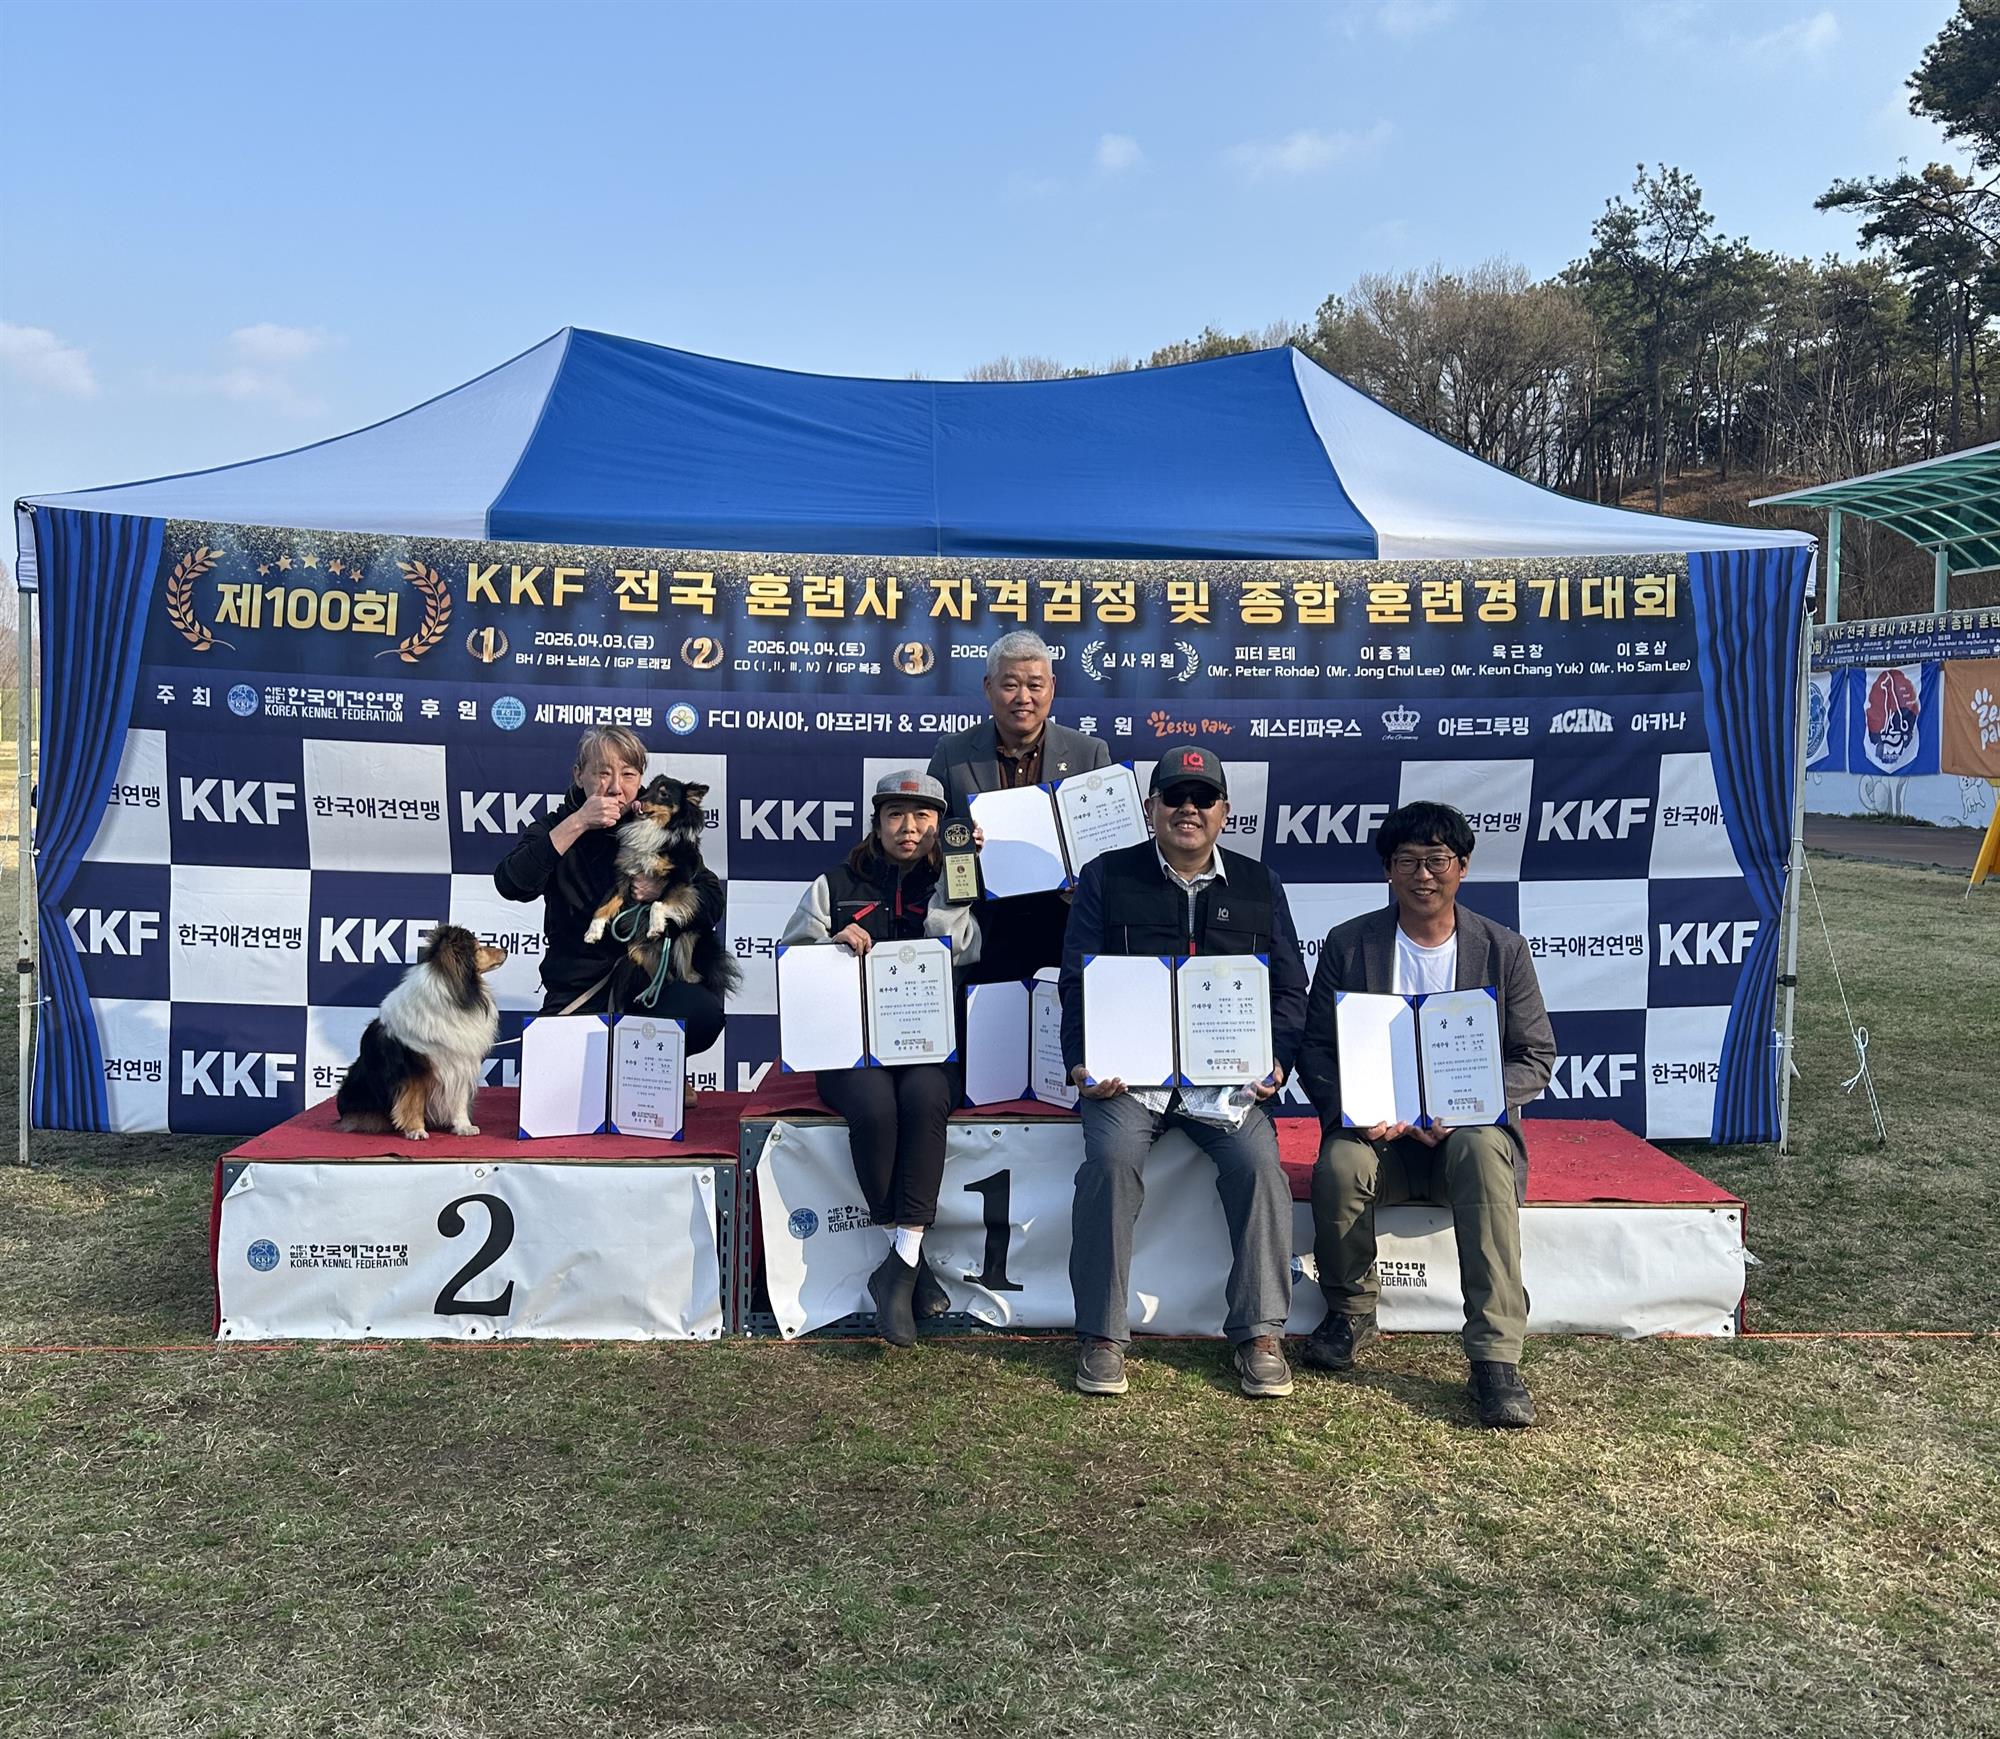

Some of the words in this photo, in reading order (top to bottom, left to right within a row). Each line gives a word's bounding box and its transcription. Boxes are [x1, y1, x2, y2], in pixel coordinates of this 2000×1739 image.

[466, 562, 585, 606] KKF
[614, 569, 716, 615] 전국
[746, 572, 902, 619] 훈련사
[928, 579, 1136, 623] 자격검정
[1167, 580, 1211, 624] 및
[1238, 580, 1340, 624] 종합
[1366, 574, 1676, 623] 훈련경기대회
[214, 583, 398, 636] 제100회
[534, 632, 654, 650] 2026.04.03.(금)
[1829, 628, 1844, 640] KKF
[748, 640, 866, 657] 2026.04.04.(토)
[1235, 647, 1262, 661] 피터
[1268, 647, 1296, 661] 로데
[516, 654, 533, 664] BH
[546, 655, 564, 666] BH
[566, 656, 600, 668] 노비스
[614, 658, 634, 668] IGP
[637, 658, 672, 670] 트래킹
[734, 660, 750, 671] CD
[836, 662, 856, 674] IGP
[1208, 666, 1232, 678] (Mr.
[1236, 666, 1272, 677] Peter
[1275, 666, 1320, 678] Rohde)
[1326, 666, 1352, 678] (Mr.
[1354, 666, 1384, 679] Jong
[1388, 665, 1414, 676] Chul
[1417, 664, 1445, 676] Lee)
[1451, 664, 1476, 676] (Mr.
[1480, 664, 1510, 675] Keun
[1514, 664, 1552, 677] Chang
[1556, 662, 1584, 674] Yuk)
[1590, 662, 1614, 674] (Mr.
[1618, 662, 1634, 672] Ho
[1638, 660, 1662, 672] Sam
[1666, 660, 1690, 672] Lee)
[288, 687, 404, 710] 한국애견연맹
[265, 704, 298, 717] KOREA
[302, 706, 338, 720] KENNEL
[342, 708, 404, 722] FEDERATION
[534, 704, 652, 726] 세계애견연맹
[708, 710, 740, 728] FCI
[746, 710, 809, 732] 아시아,
[816, 712, 892, 732] 아프리카
[1550, 708, 1614, 734] ACANA
[1631, 712, 1686, 732] 아카나
[1250, 719, 1362, 737] 제스티파우스
[1438, 716, 1530, 736] 아트그루밍
[180, 776, 296, 825] KKF
[314, 796, 440, 821] 한국애견연맹
[740, 800, 854, 841] KKF
[1276, 804, 1390, 844] KKF
[1538, 798, 1650, 841] KKF
[1662, 804, 1724, 826] 한국애
[178, 923, 301, 949] 한국애견연맹
[320, 918, 439, 964] KKF
[1528, 934, 1644, 958] 한국애견연맹
[1659, 920, 1760, 966] KKF
[182, 1050, 297, 1098] KKF
[828, 1221, 854, 1234] KOREA
[963, 1168, 1024, 1292] 1
[310, 1244, 408, 1259] 한국애견연맹
[434, 1193, 514, 1316] 2
[290, 1258, 320, 1268] KOREA
[322, 1258, 353, 1268] KENNEL
[355, 1258, 408, 1268] FEDERATION
[1381, 1276, 1428, 1288] EDERATION
